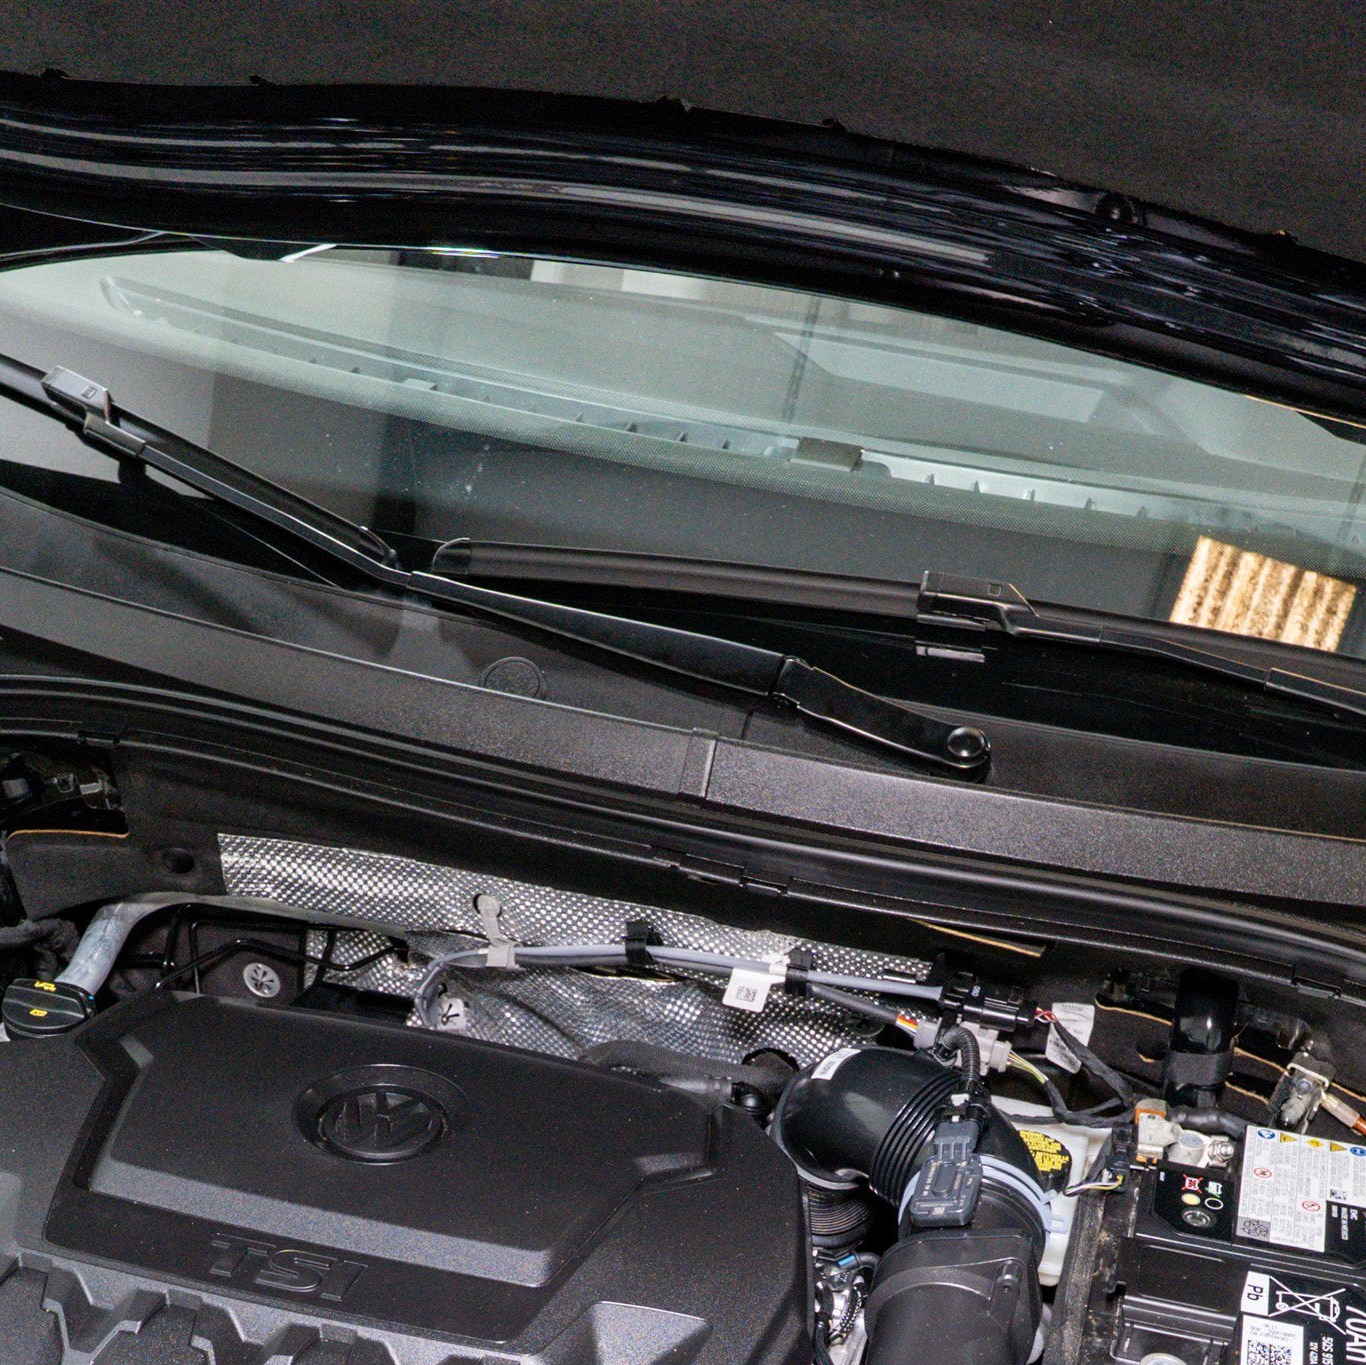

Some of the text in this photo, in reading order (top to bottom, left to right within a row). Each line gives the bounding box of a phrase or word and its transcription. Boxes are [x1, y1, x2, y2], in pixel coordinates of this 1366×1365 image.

[208, 1232, 369, 1302] TSI
[1246, 1284, 1263, 1300] Pb
[1321, 1352, 1332, 1365] 915
